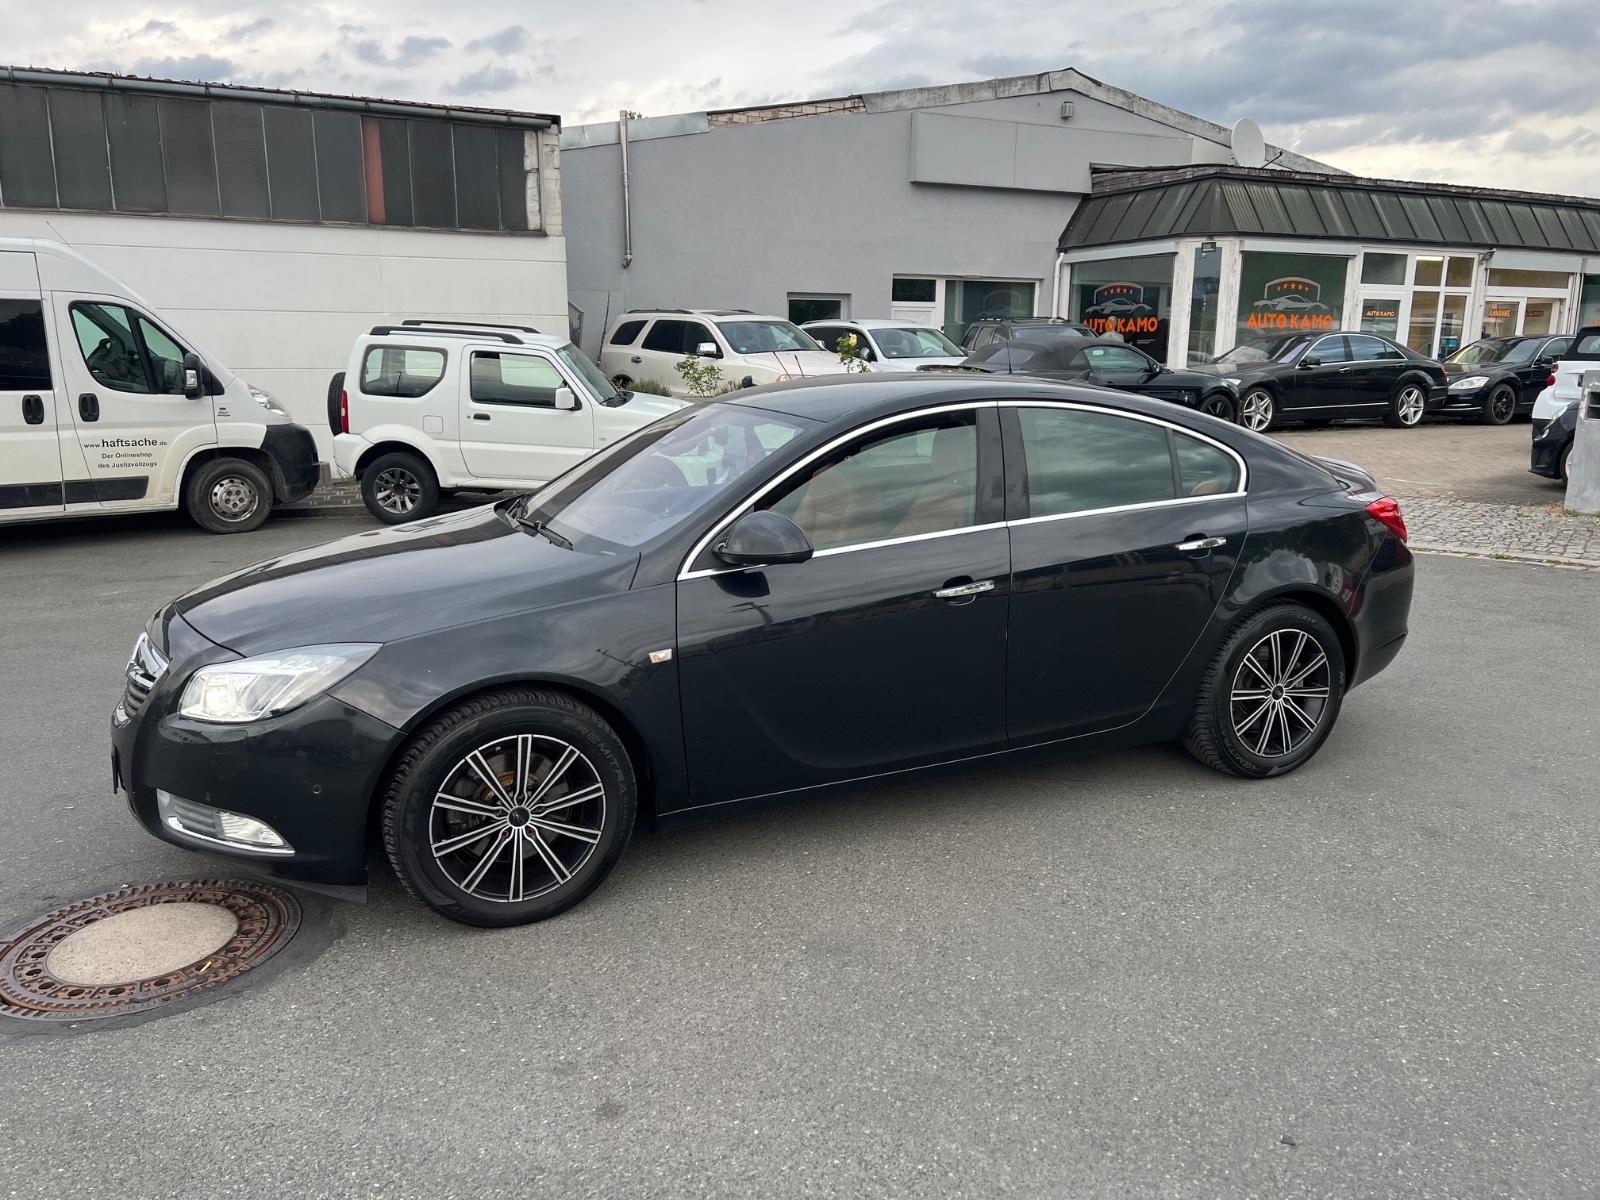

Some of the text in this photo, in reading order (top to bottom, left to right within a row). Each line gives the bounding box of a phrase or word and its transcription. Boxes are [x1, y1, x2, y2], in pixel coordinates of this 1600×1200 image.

[1117, 317, 1158, 333] KAMO
[1246, 312, 1334, 330] AUTO KAMO
[112, 461, 158, 469] Justizvollzugs
